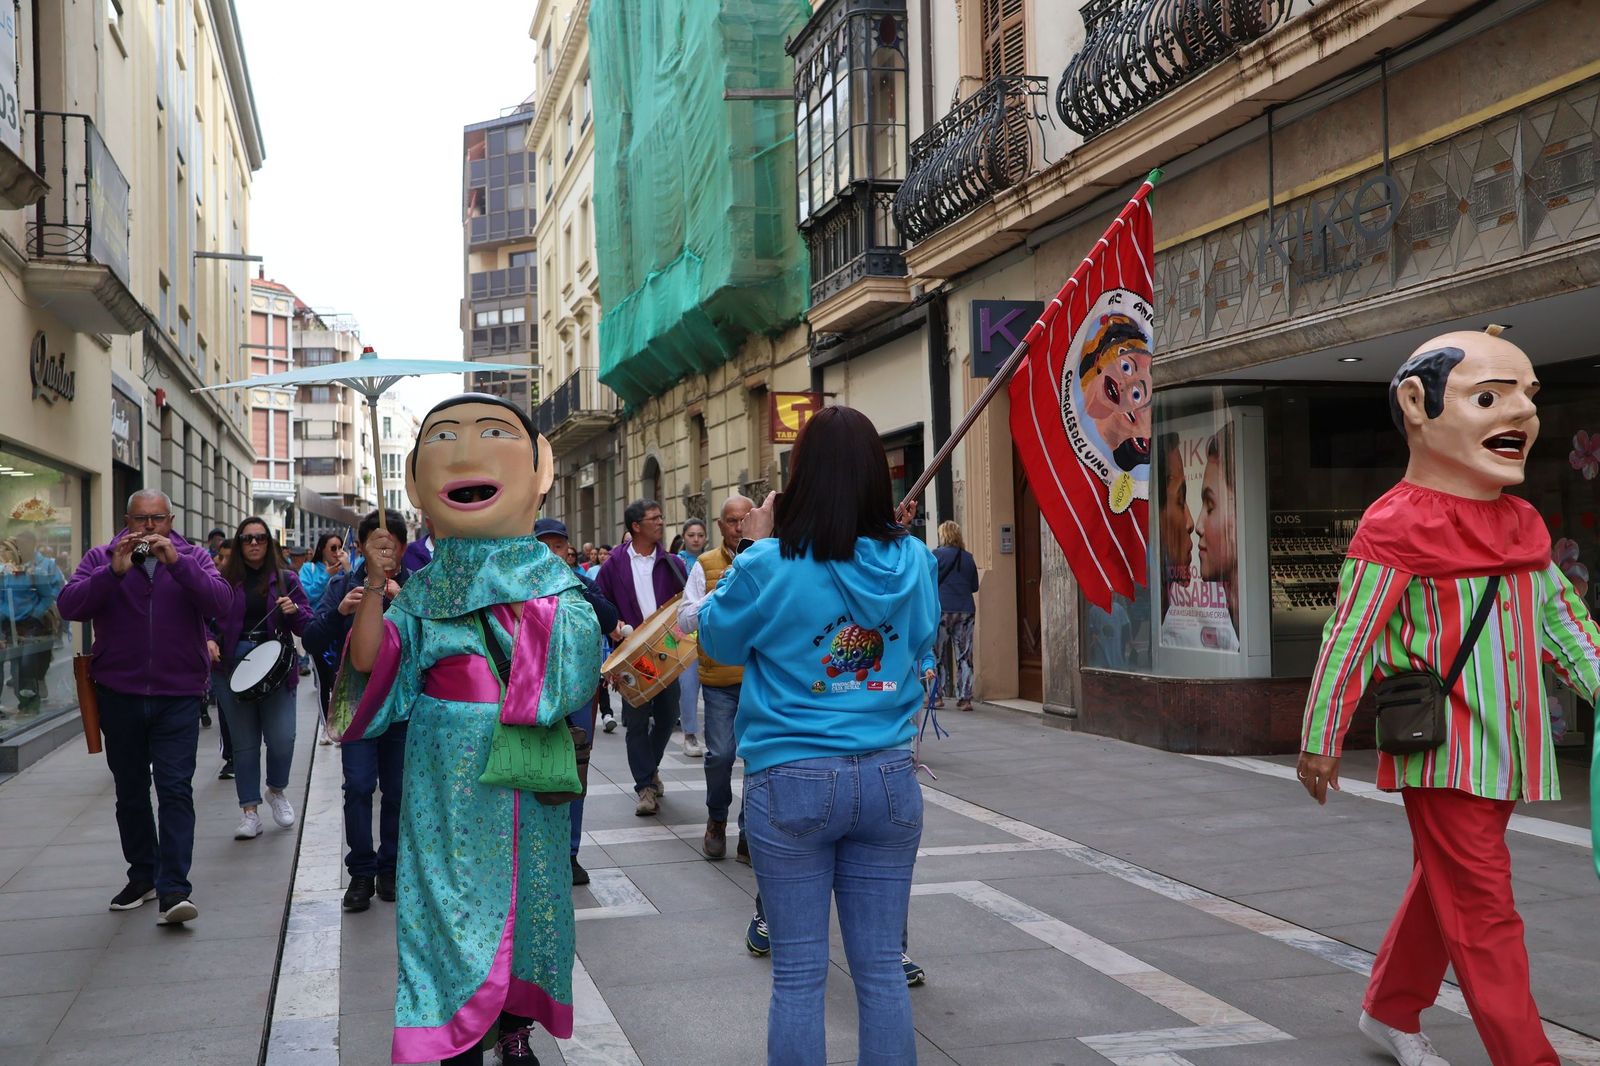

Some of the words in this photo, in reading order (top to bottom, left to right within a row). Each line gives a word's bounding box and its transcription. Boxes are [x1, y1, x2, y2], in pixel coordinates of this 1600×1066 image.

[1257, 175, 1402, 280] KIKO
[979, 307, 1027, 353] K
[775, 431, 798, 439] TABA
[1274, 514, 1302, 524] OJOS
